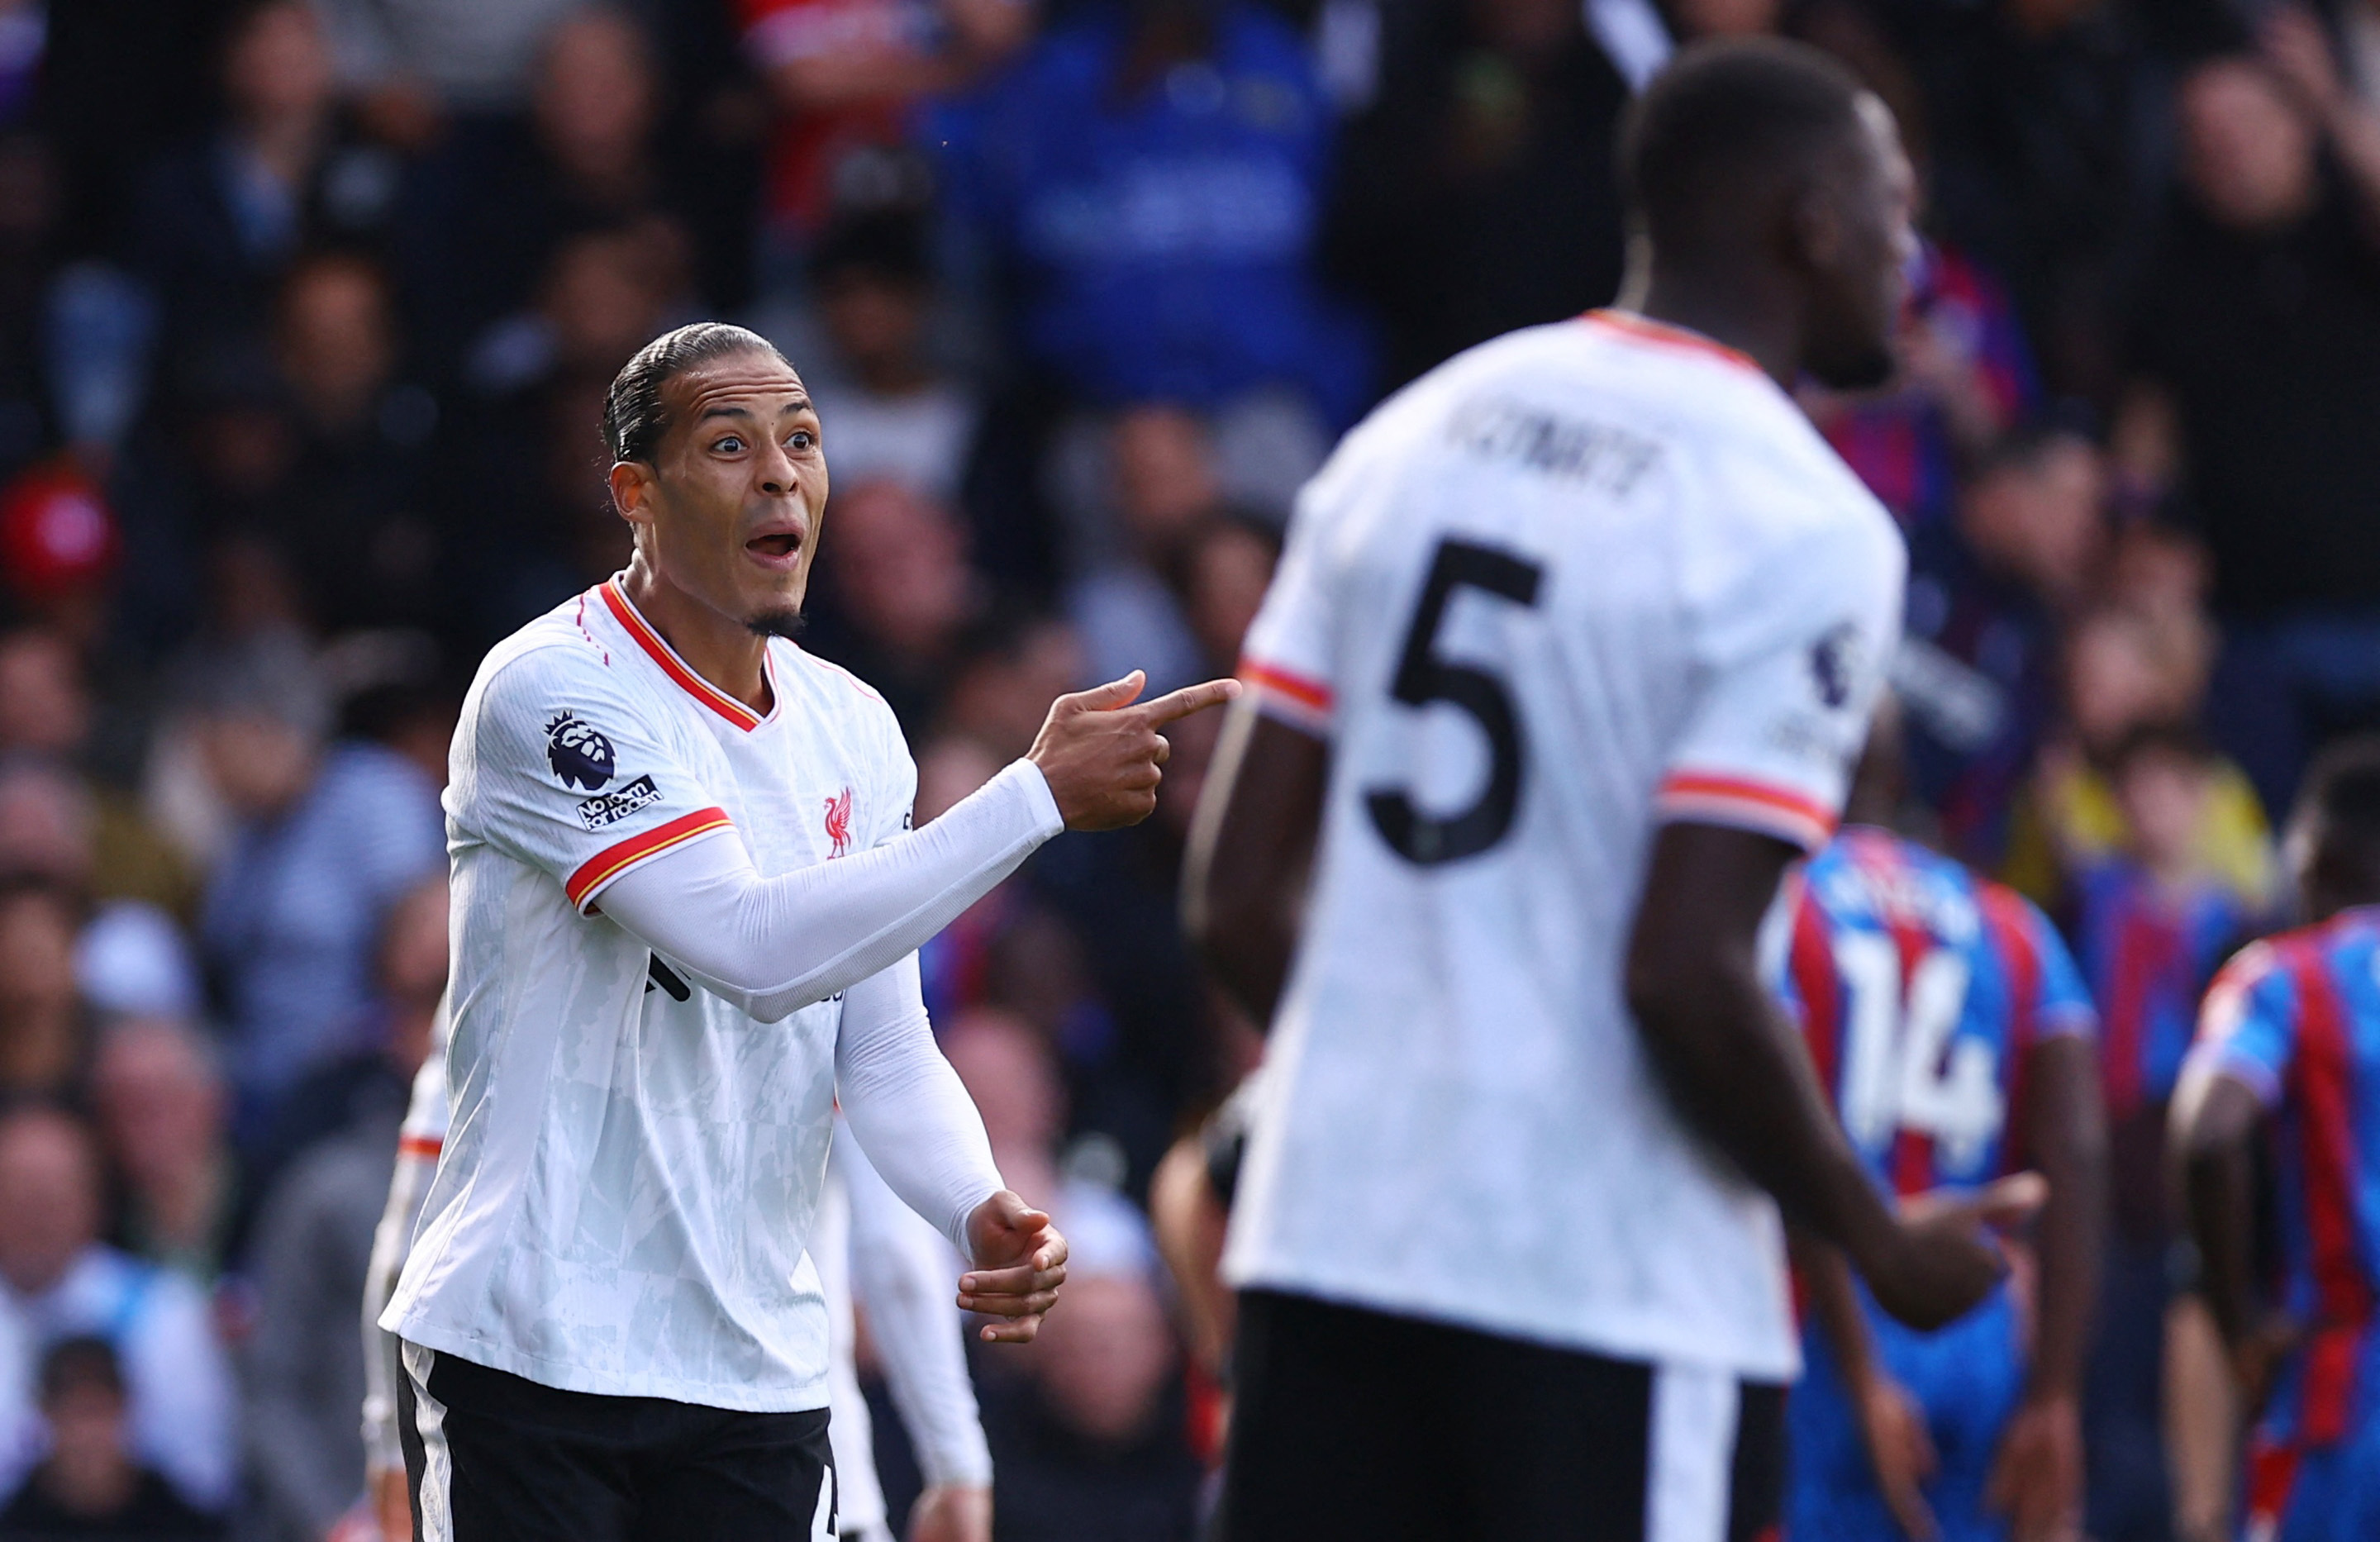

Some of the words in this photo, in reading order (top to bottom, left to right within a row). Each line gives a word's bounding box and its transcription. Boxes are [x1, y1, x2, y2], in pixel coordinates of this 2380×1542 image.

[1365, 531, 1547, 868] 5
[577, 800, 605, 820] No
[606, 783, 648, 807] room
[584, 811, 608, 830] for
[1833, 930, 2006, 1175] 14
